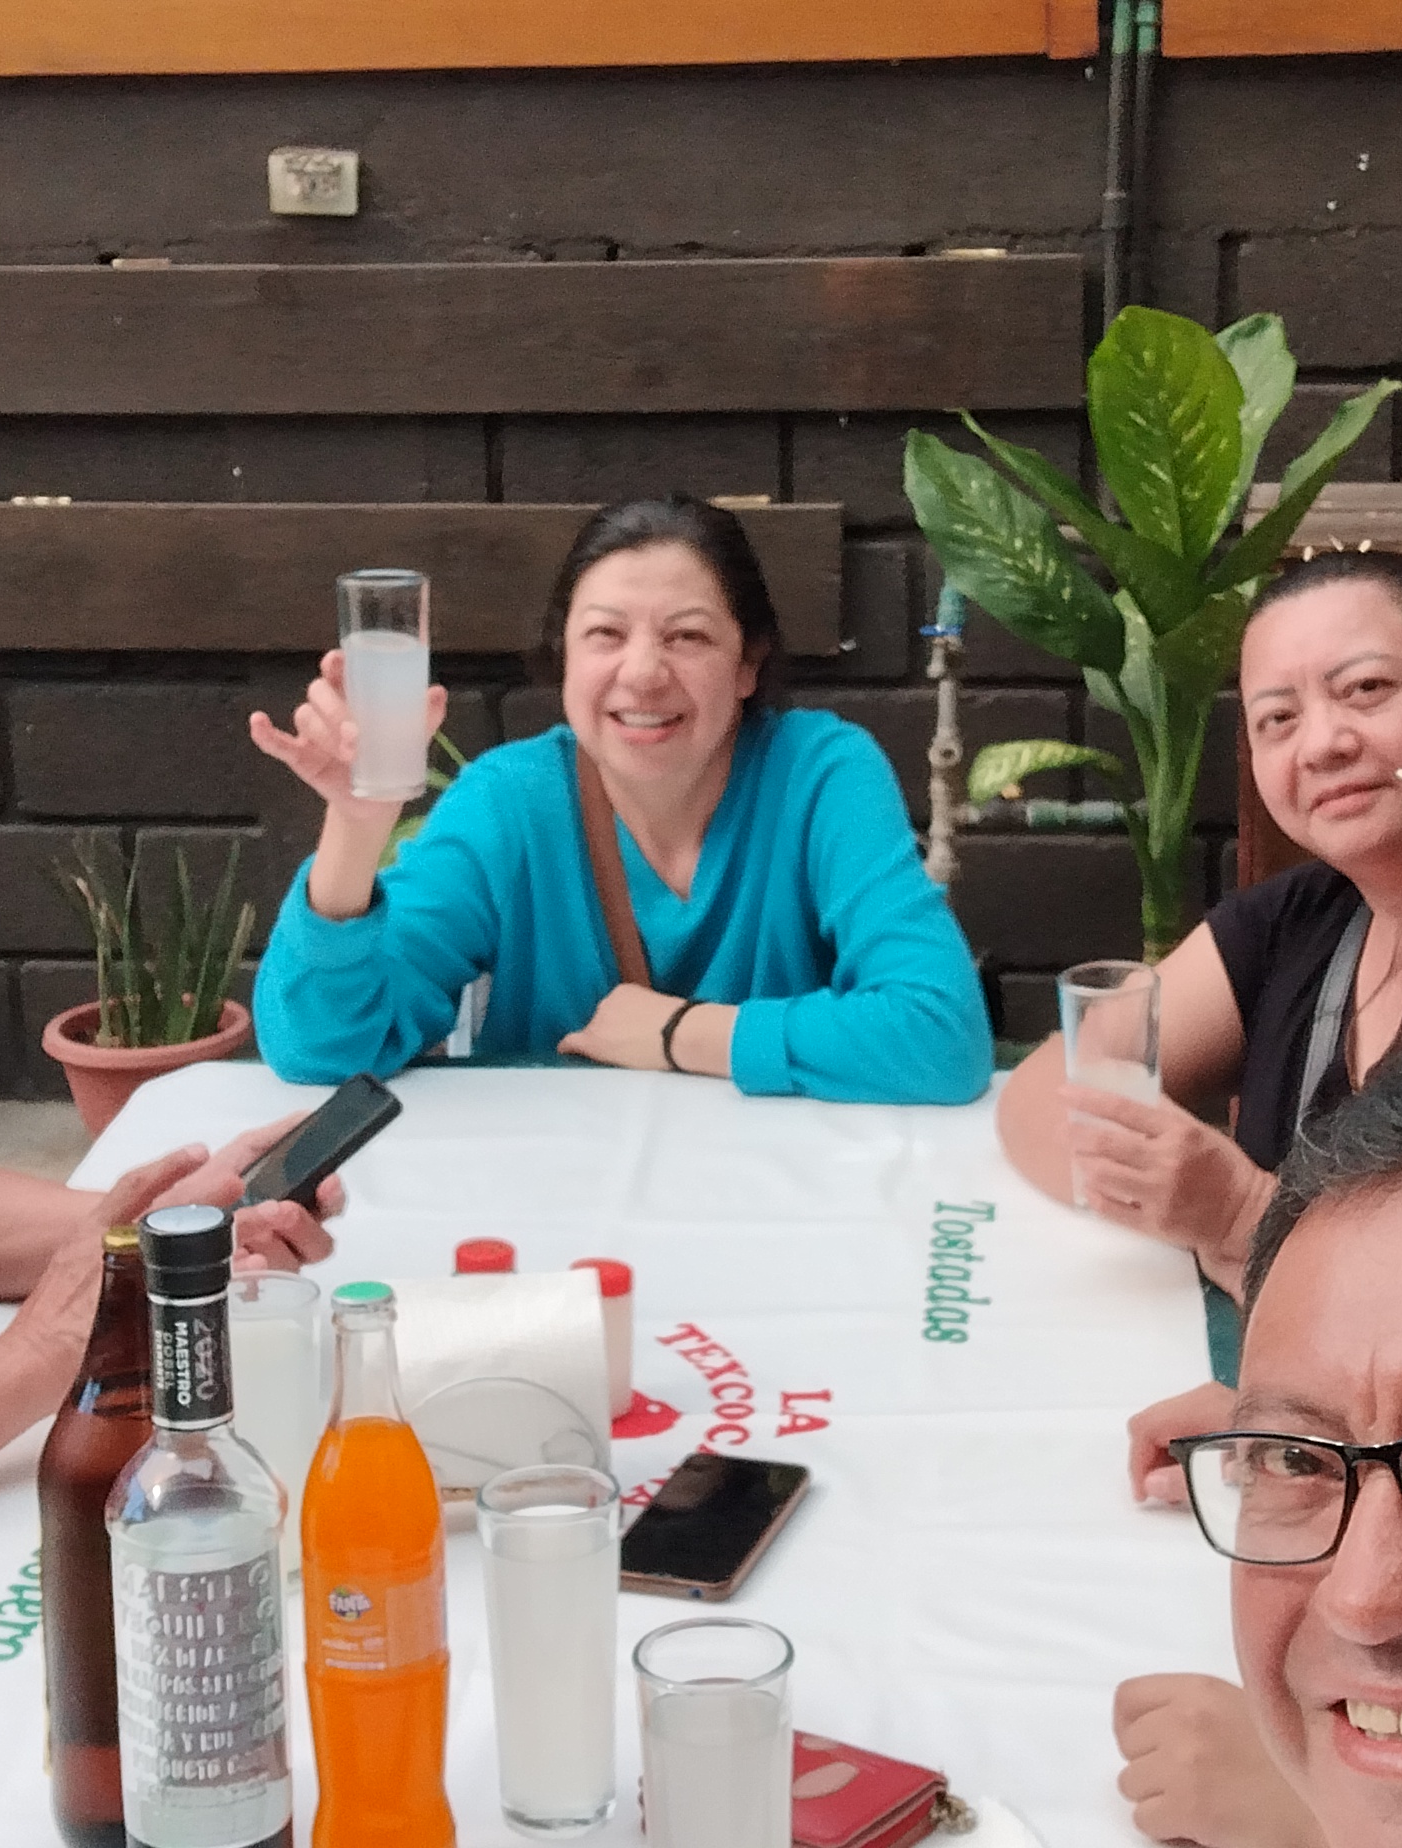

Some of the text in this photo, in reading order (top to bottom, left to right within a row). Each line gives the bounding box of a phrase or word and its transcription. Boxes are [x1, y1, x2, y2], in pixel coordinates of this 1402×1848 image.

[922, 1199, 996, 1344] Tostadas
[174, 1321, 192, 1406] MAESTRO
[775, 1389, 832, 1437] LA
